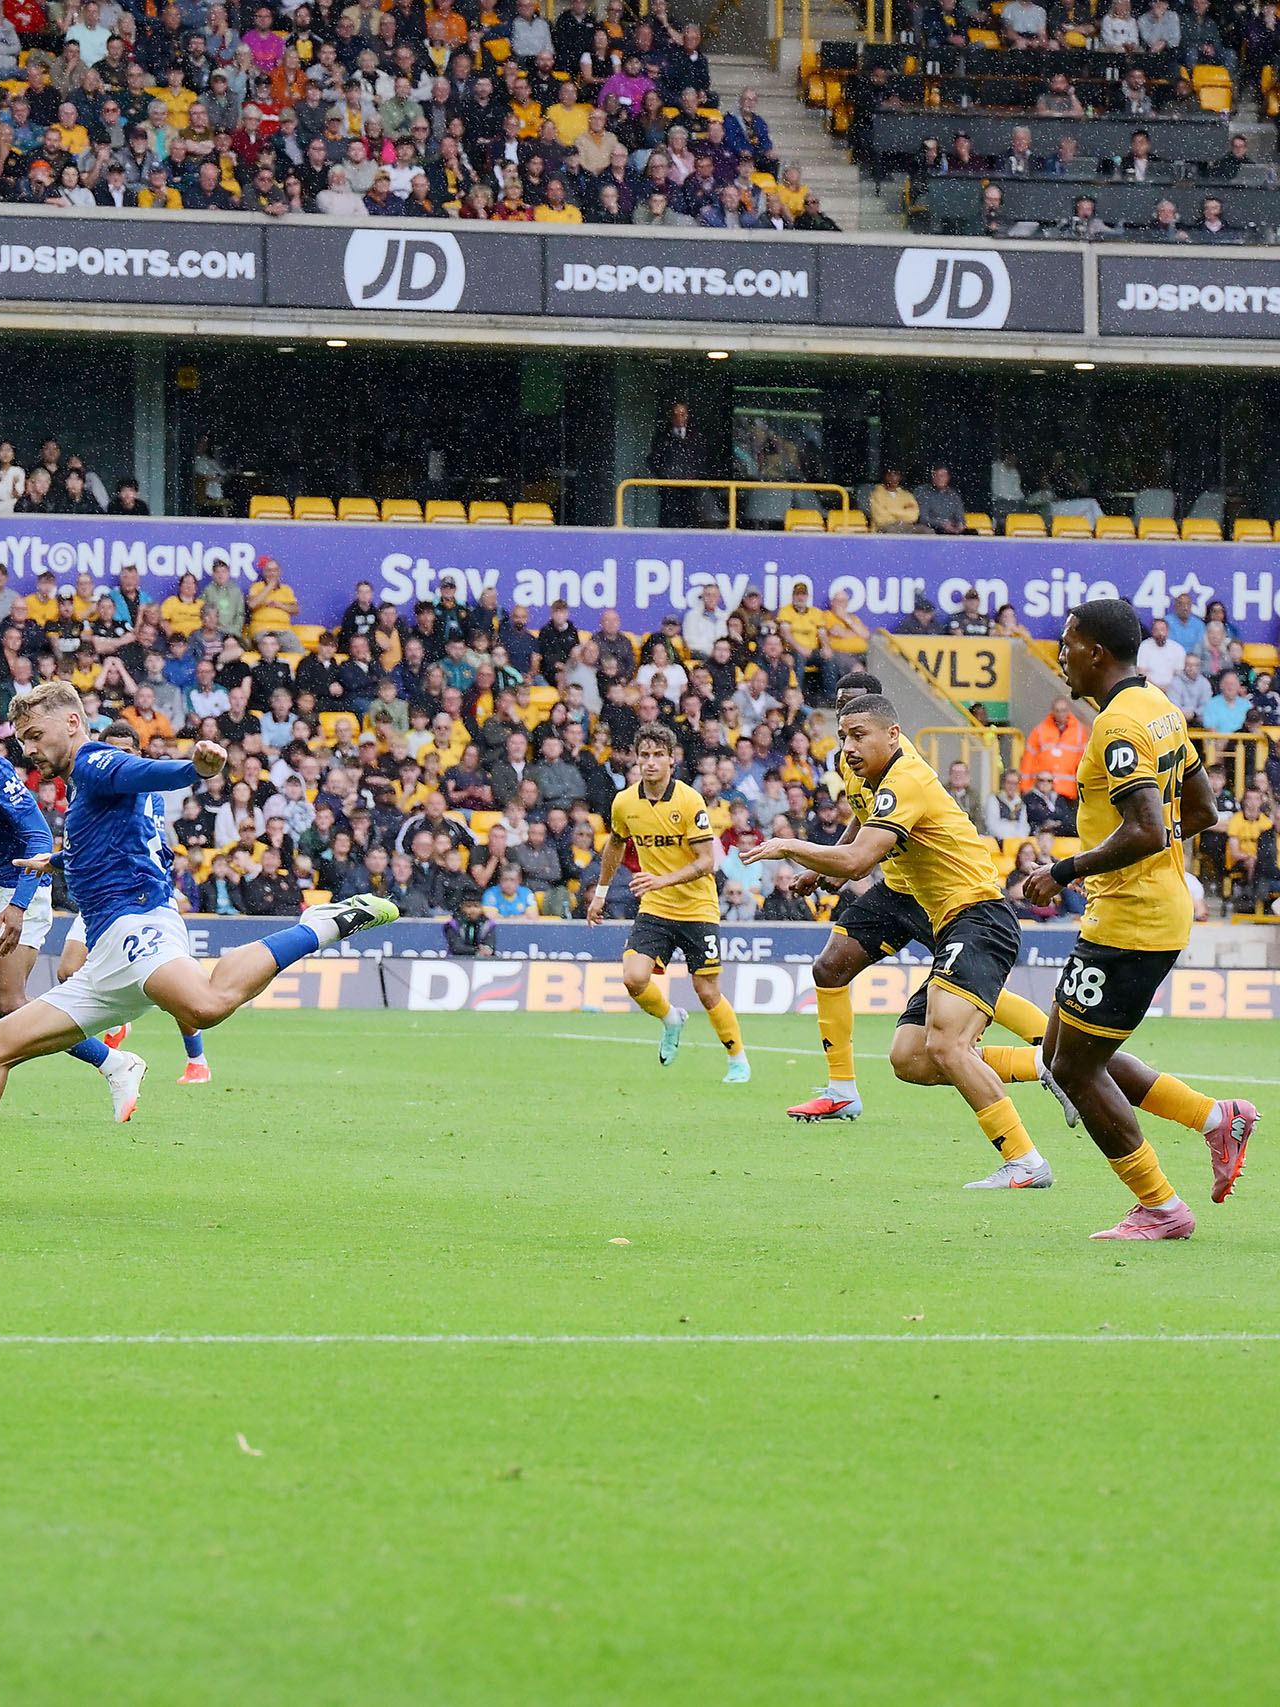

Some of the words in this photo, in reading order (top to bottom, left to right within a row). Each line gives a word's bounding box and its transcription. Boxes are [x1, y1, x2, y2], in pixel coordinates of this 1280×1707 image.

[362, 239, 447, 300] JD
[555, 264, 808, 298] JDSPORTS.COM
[913, 259, 994, 319] JD
[513, 559, 617, 609] and
[635, 558, 750, 614] Play
[764, 561, 814, 611] in
[828, 575, 926, 614] our
[937, 577, 1009, 615] on
[1232, 571, 1280, 621] H
[1108, 746, 1135, 772] JD
[122, 926, 164, 963] 23
[703, 934, 719, 959] 3
[943, 942, 964, 971] 7
[1063, 956, 1107, 1007] 38
